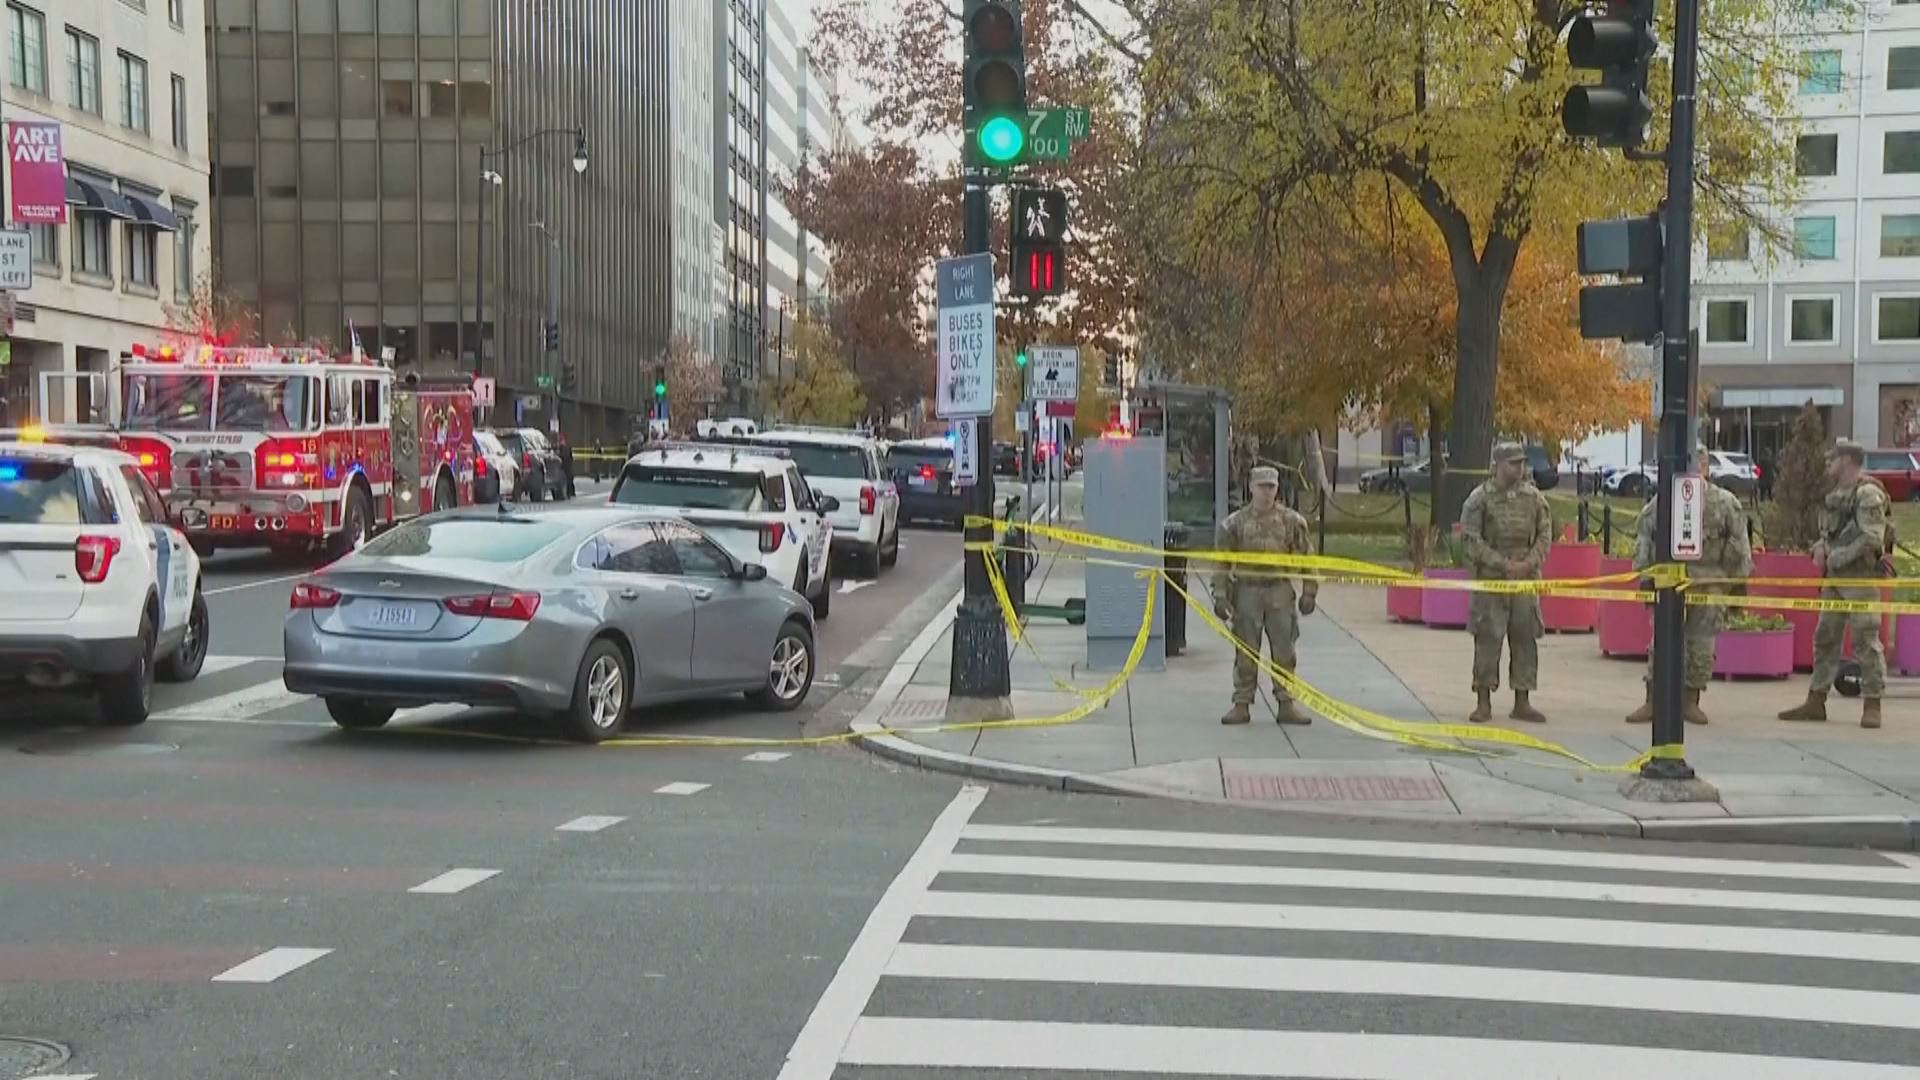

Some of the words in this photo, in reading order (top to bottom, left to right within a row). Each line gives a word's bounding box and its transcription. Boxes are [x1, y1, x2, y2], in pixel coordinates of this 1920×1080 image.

[1065, 110, 1083, 126] ST
[13, 127, 59, 145] ART
[1065, 123, 1084, 137] NW
[14, 145, 58, 162] AVE
[2, 271, 25, 283] LEFT
[952, 264, 975, 281] RIGHT
[955, 285, 975, 301] LANE
[949, 312, 983, 332] BUSES
[949, 333, 983, 352] BIKES
[950, 353, 982, 371] ONLY
[1042, 351, 1063, 359] BEGIN
[302, 439, 317, 452] 16
